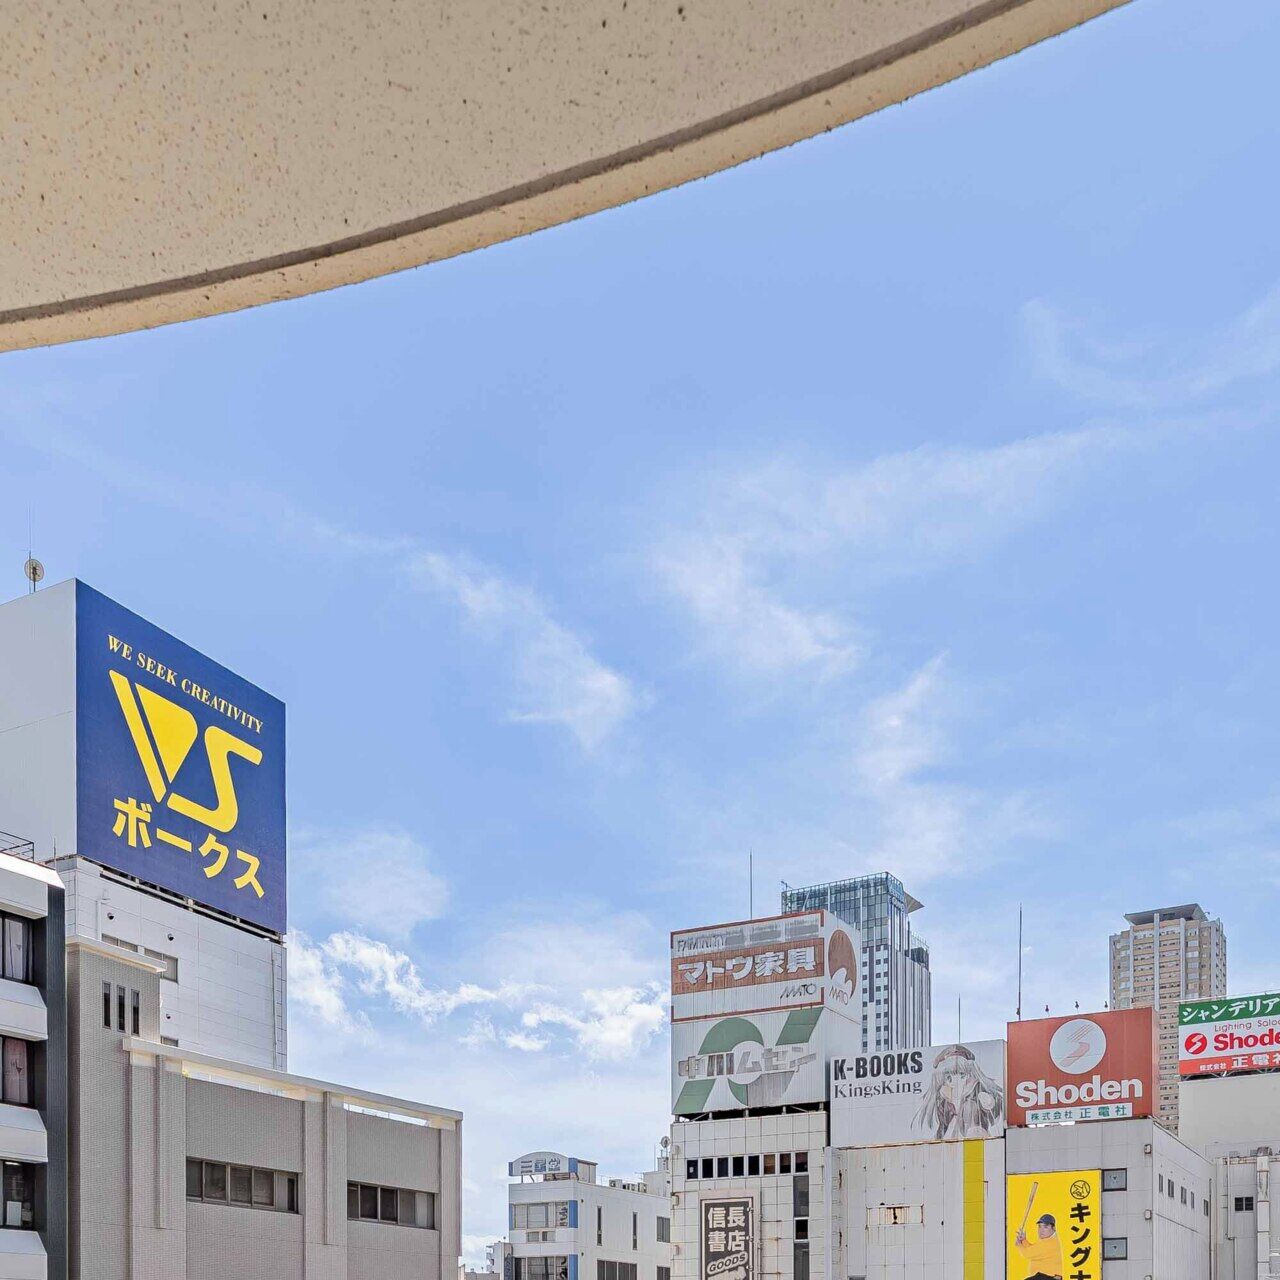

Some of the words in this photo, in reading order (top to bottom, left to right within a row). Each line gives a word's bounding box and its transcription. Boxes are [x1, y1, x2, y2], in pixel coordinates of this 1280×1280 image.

[107, 634, 133, 661] WE
[136, 651, 178, 688] SEEK
[181, 678, 264, 735] CREATIVITY
[111, 796, 265, 899] ボークス
[677, 945, 817, 985] マトウ家具
[779, 983, 818, 1000] MATO
[1214, 1021, 1252, 1033] Lighting
[833, 1051, 923, 1081] K-BOOKS
[833, 1079, 923, 1099] KingsKing
[1015, 1075, 1143, 1108] Shoden
[1030, 1110, 1073, 1121] 株式会社
[1079, 1105, 1127, 1119] 正電社
[707, 1206, 746, 1229] 信長
[707, 1231, 746, 1252] 書店
[709, 1253, 746, 1272] GOODS
